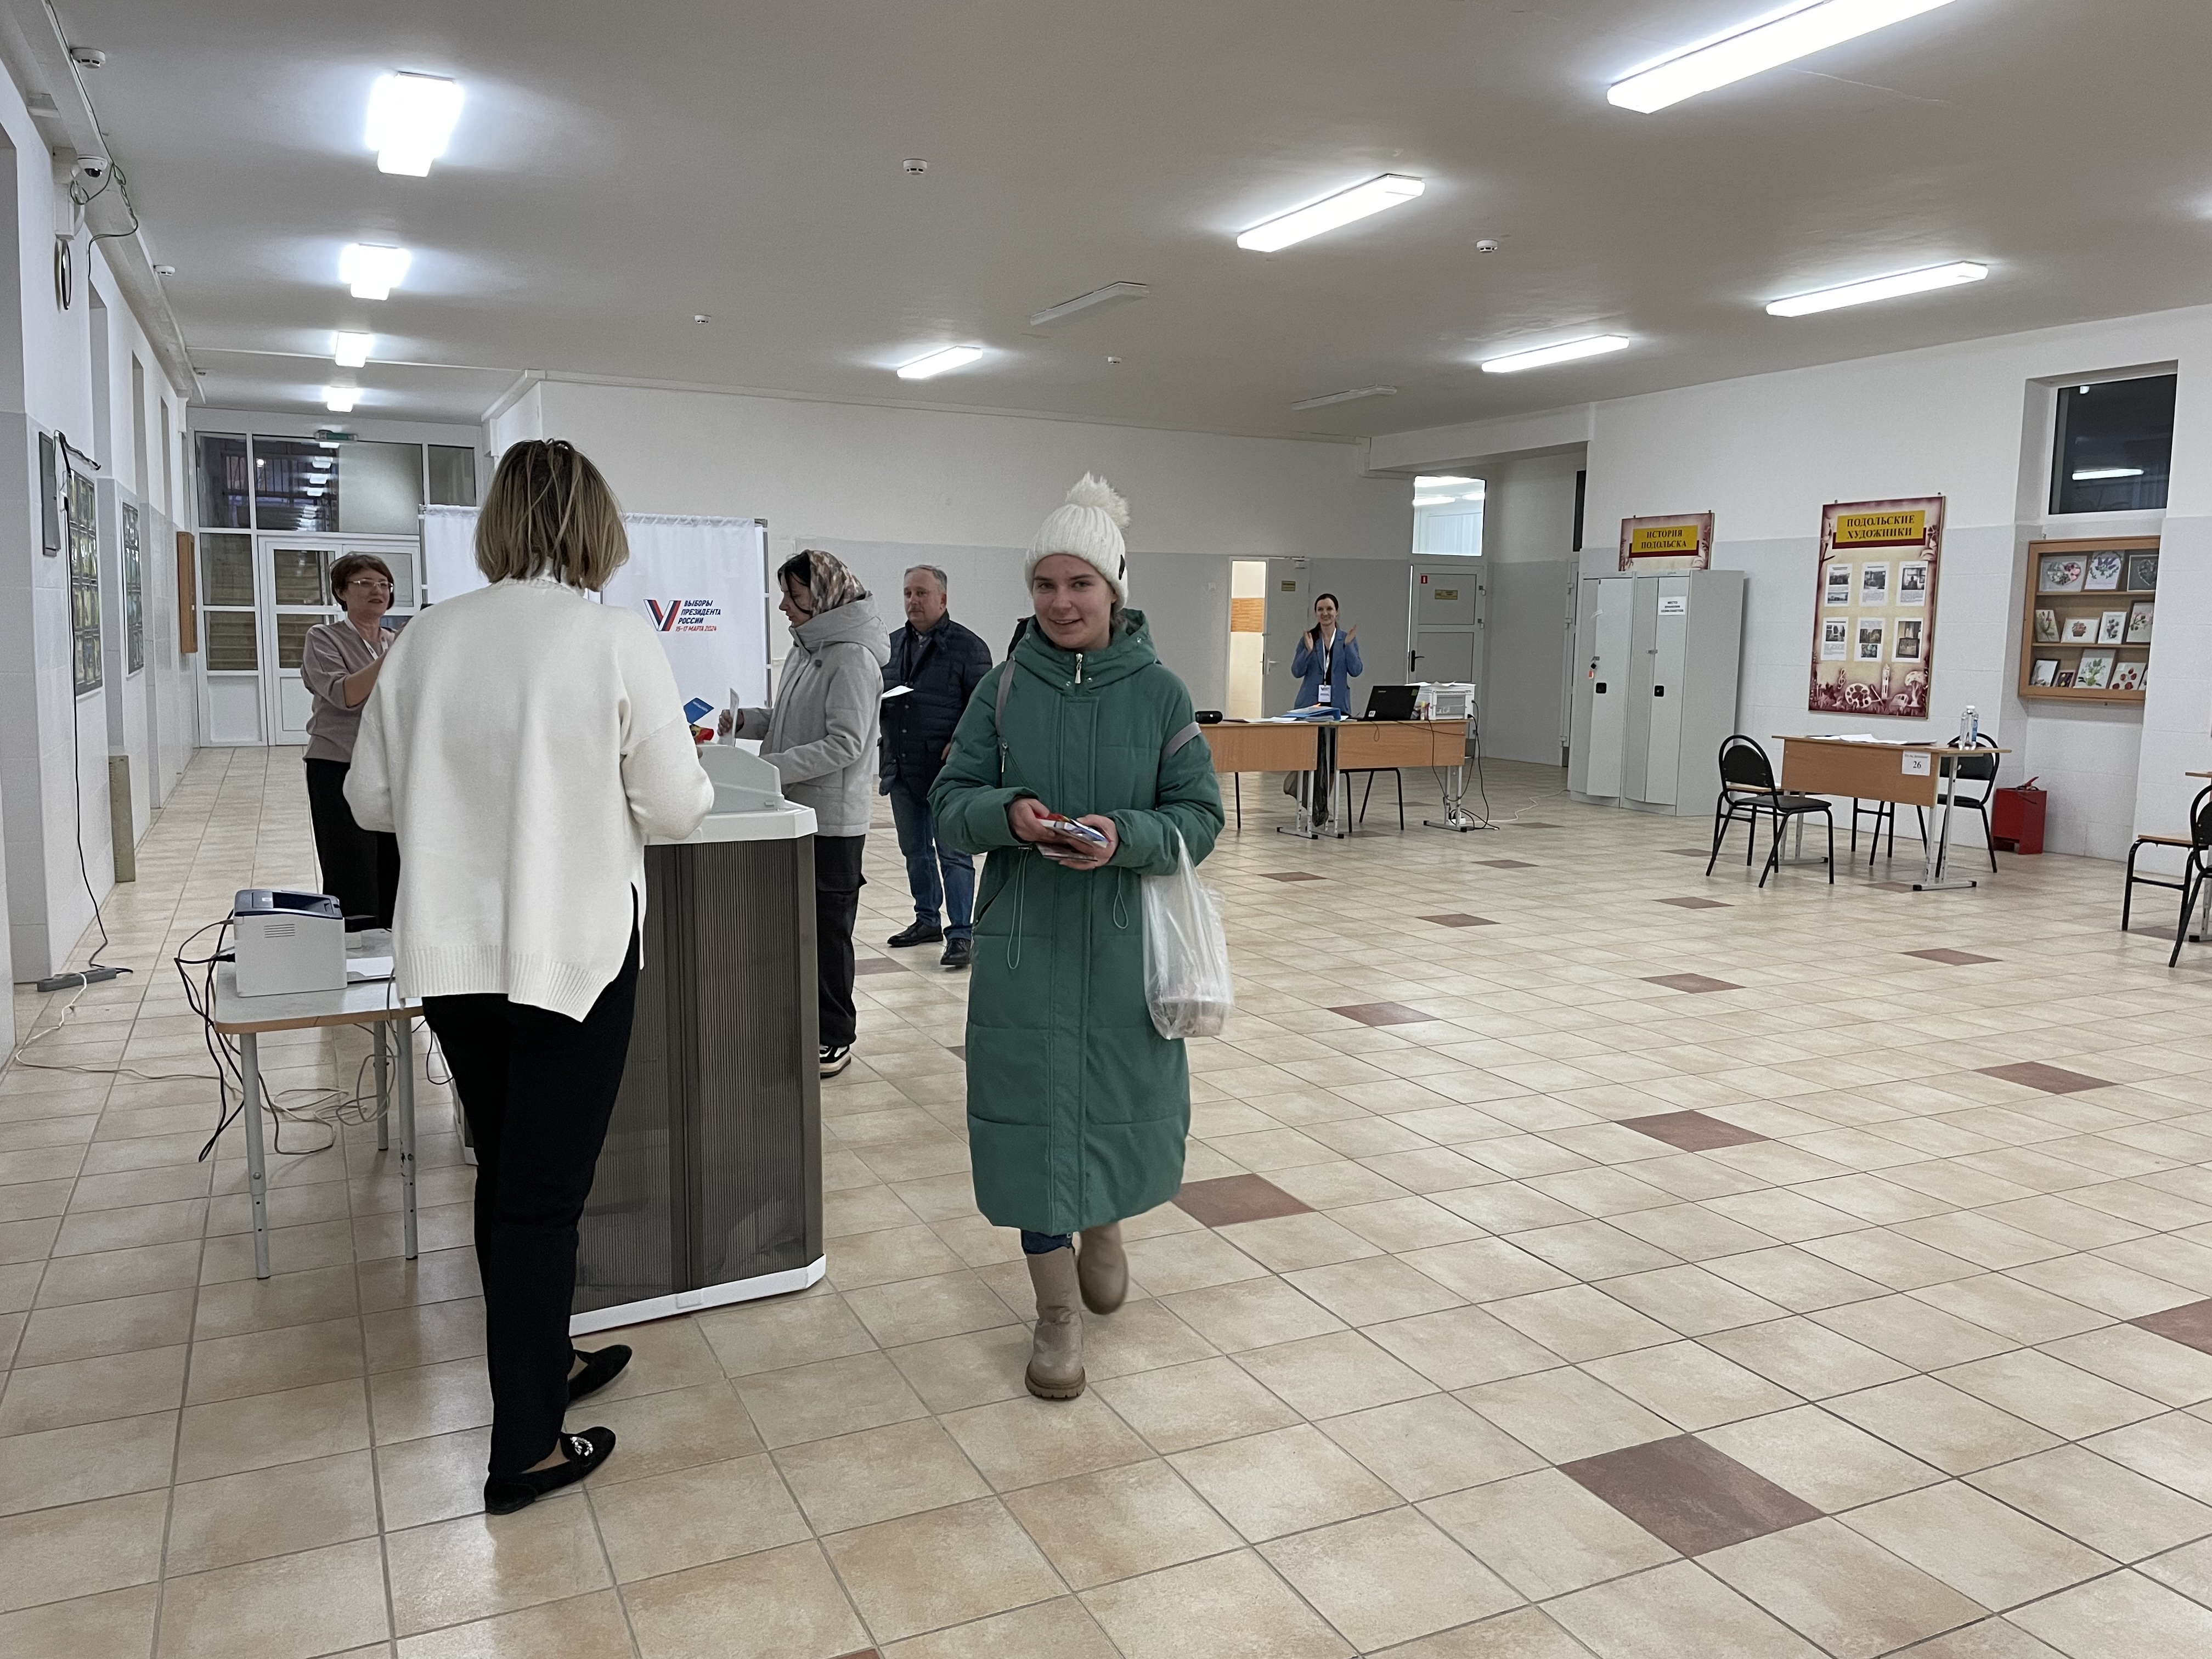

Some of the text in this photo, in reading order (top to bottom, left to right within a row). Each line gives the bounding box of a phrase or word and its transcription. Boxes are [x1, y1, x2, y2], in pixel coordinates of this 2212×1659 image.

[1847, 515, 1915, 527] ПОДОЛЬСКИЕ
[1647, 529, 1683, 538] ИСТОРИЯ
[1847, 527, 1912, 540] ХУДОЖНИКИ
[1641, 540, 1686, 549] ПОДОЛЬСКА
[1912, 760, 1922, 769] 26
